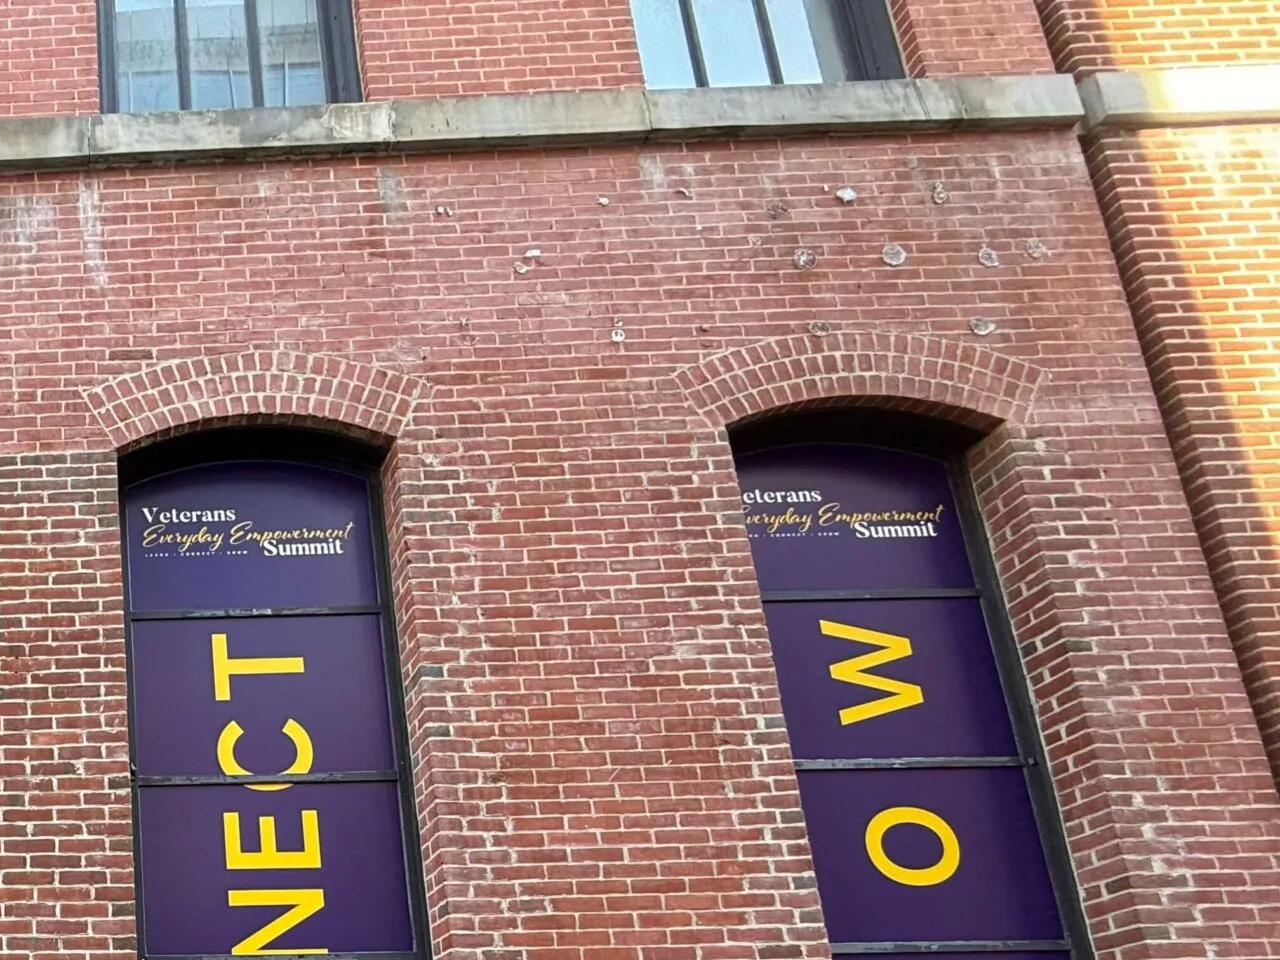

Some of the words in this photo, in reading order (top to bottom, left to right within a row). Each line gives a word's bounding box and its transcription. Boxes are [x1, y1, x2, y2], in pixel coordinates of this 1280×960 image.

[742, 489, 822, 503] eterans
[141, 507, 236, 524] Veterans
[741, 505, 813, 533] veryday
[818, 502, 944, 529] Empowerment
[142, 524, 225, 552] Everyday
[229, 521, 356, 547] Empowerment
[855, 521, 938, 538] Summit
[263, 538, 344, 557] Summit
